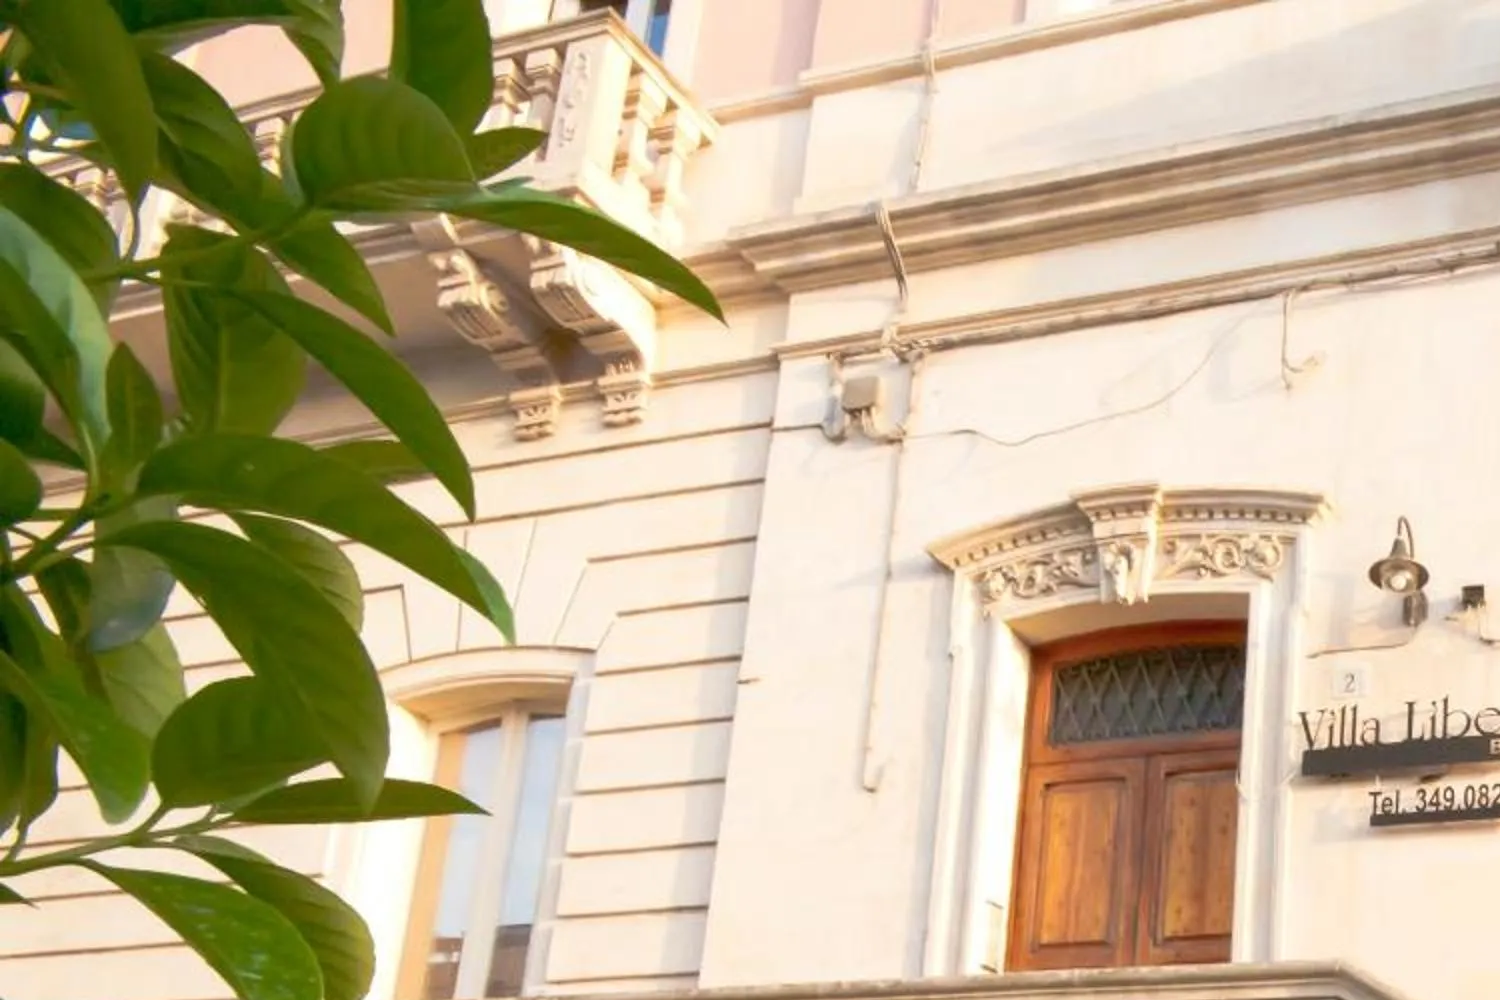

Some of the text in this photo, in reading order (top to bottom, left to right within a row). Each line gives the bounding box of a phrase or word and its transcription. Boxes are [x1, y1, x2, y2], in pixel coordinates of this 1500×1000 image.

[1343, 673, 1356, 693] 2
[1298, 703, 1381, 749] Villa
[1369, 789, 1406, 816] Tel.
